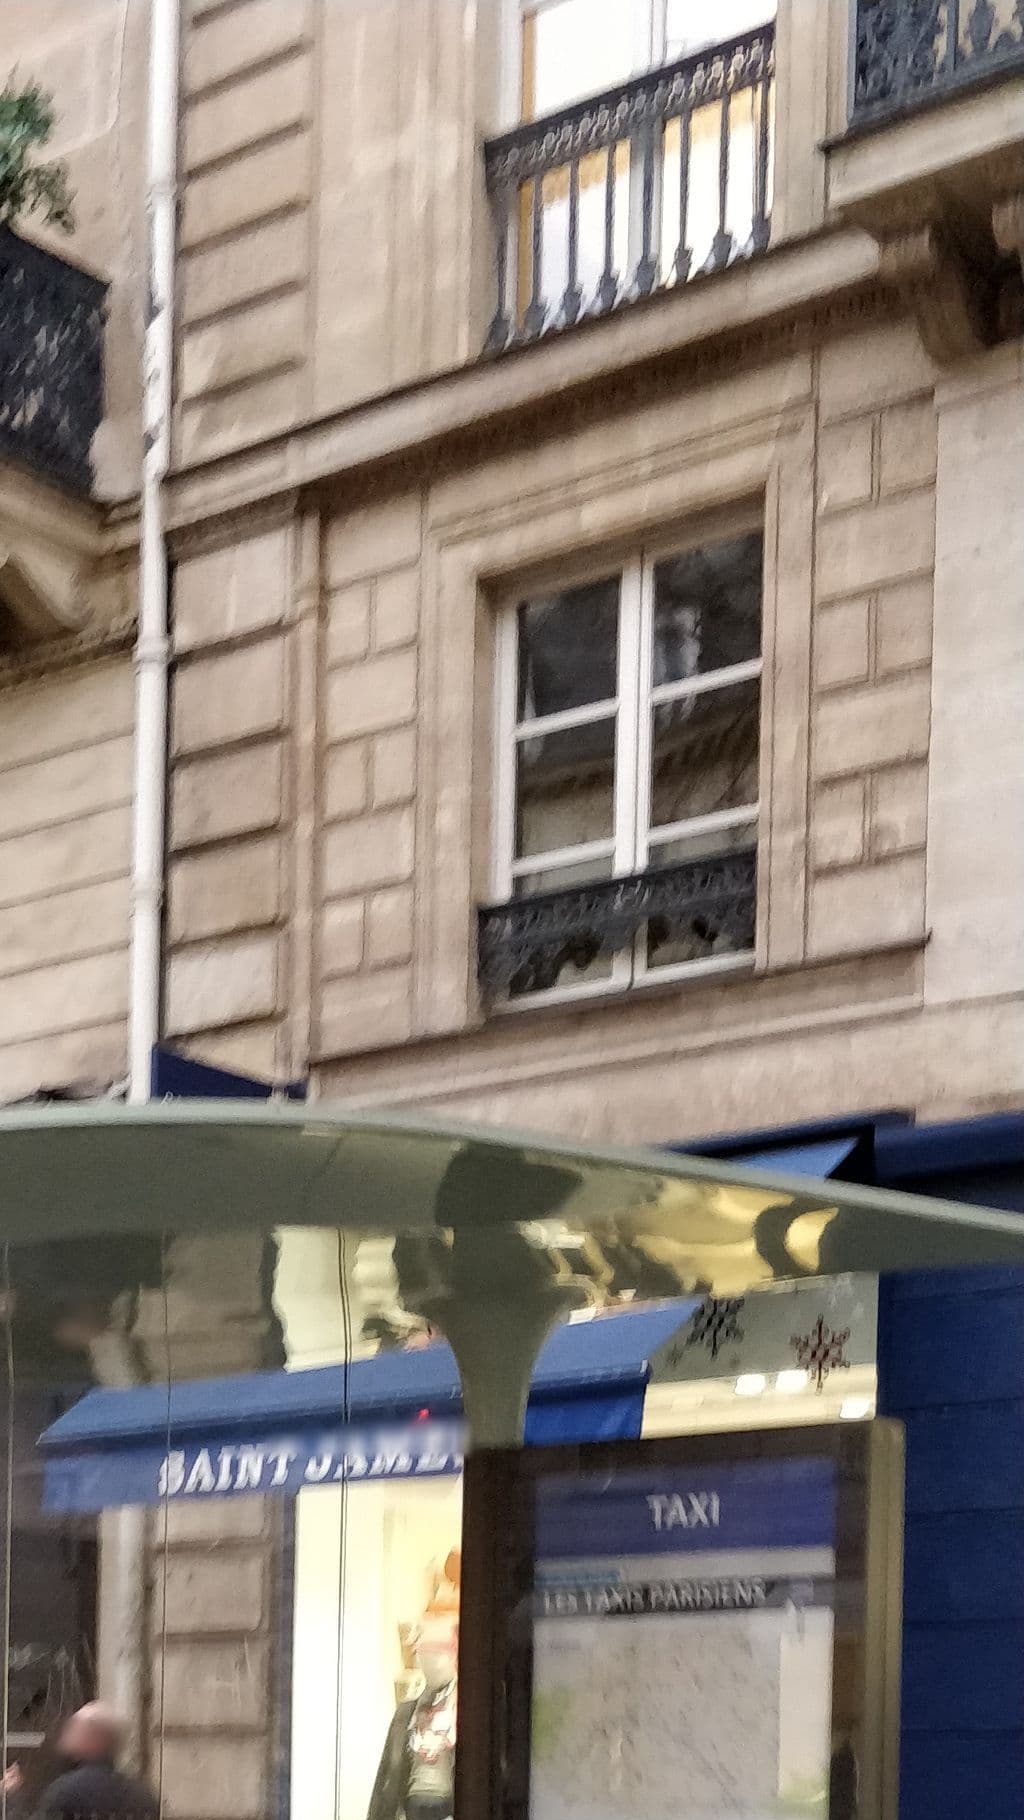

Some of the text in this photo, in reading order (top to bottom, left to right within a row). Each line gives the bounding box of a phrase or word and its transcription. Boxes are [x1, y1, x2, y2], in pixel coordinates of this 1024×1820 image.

[158, 1428, 464, 1497] SAINT JAME
[645, 1491, 720, 1531] TAXI
